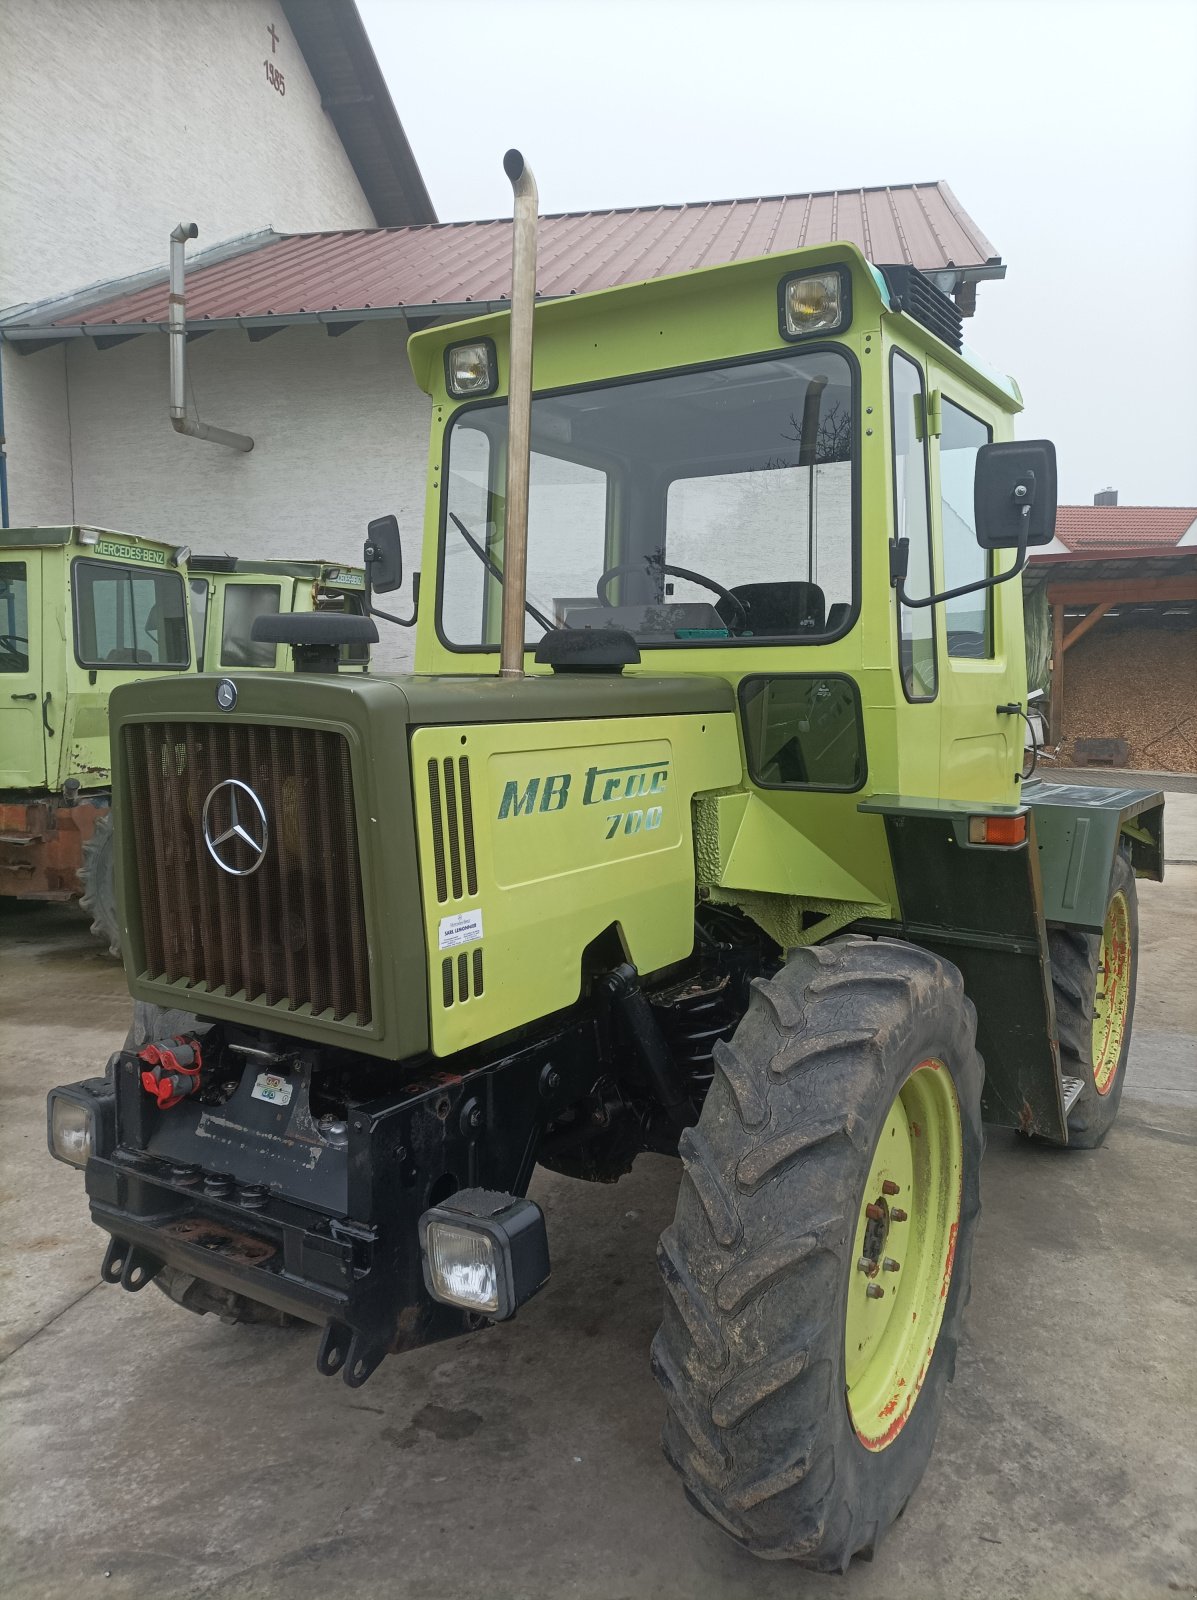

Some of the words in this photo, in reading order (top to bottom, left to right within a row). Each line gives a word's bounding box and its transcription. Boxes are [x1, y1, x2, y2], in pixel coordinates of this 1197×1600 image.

[264, 60, 285, 96] 1985
[95, 541, 164, 564] MERCEDES-BENZ
[337, 574, 362, 585] CEDES-BENZ
[498, 774, 571, 820] MB
[583, 761, 670, 806] trac
[605, 806, 663, 840] 700
